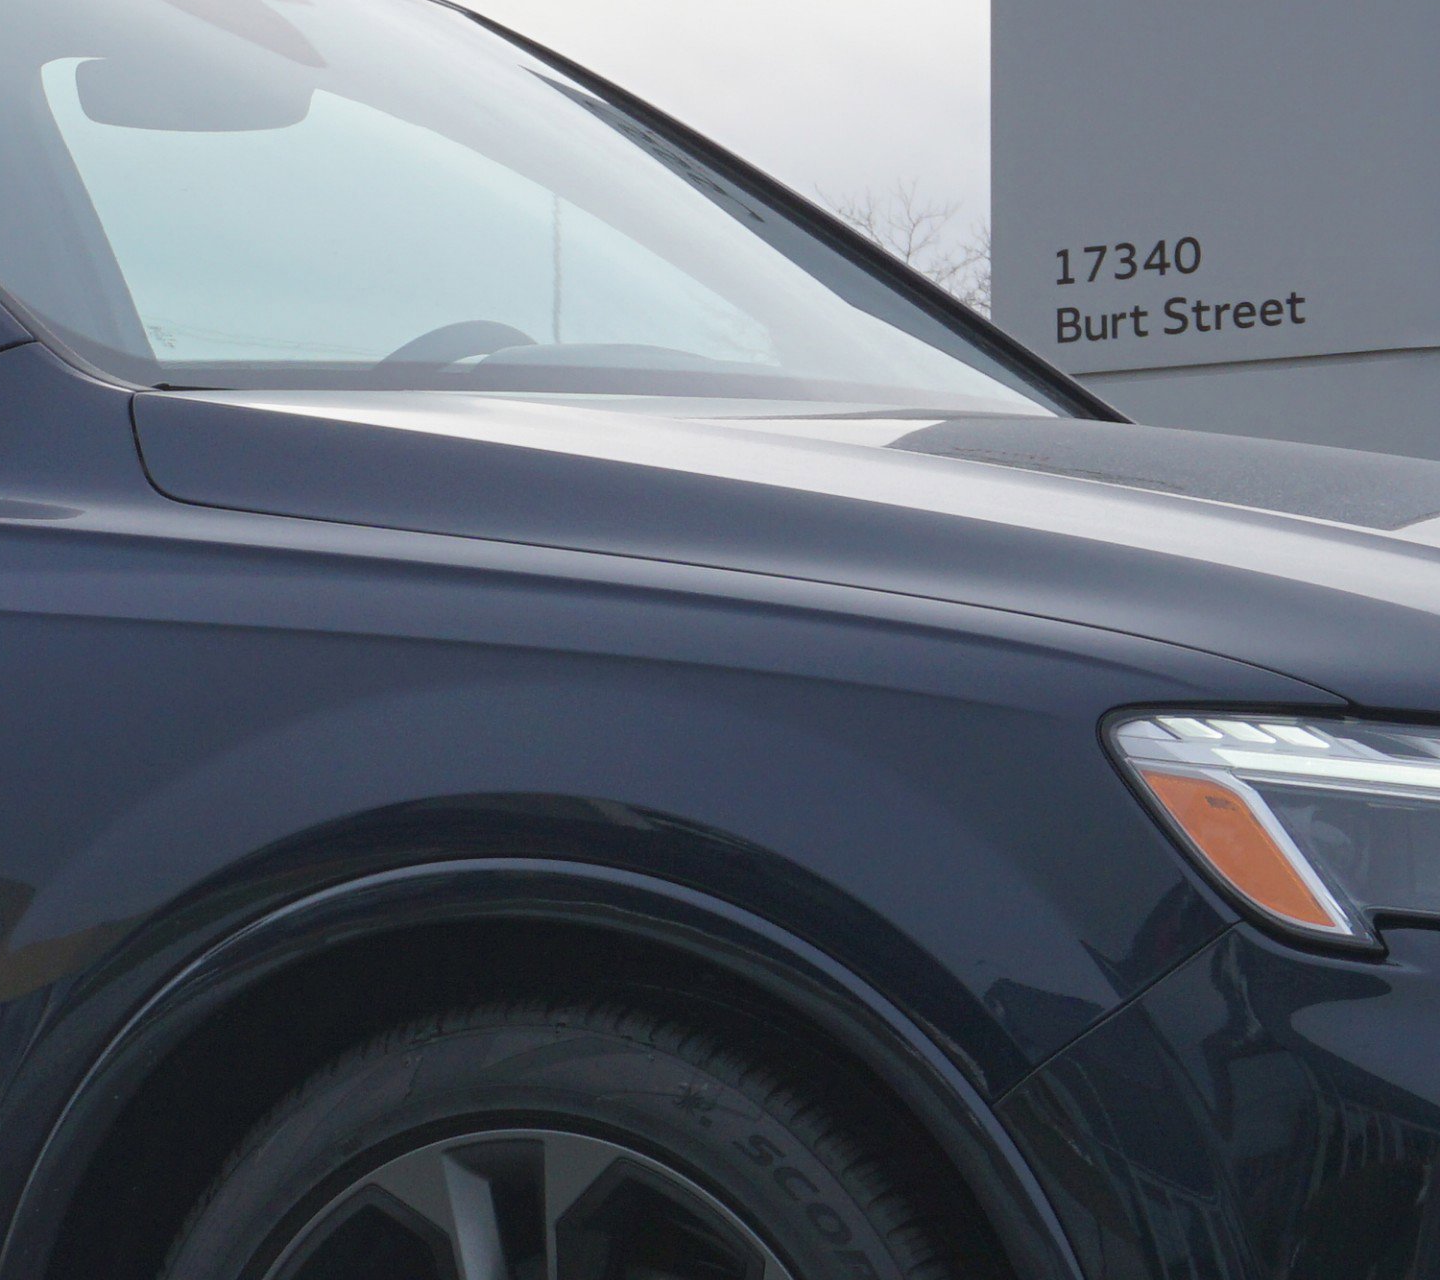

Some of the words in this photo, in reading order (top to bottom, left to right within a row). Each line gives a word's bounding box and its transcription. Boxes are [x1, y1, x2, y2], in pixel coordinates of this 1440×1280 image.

[1055, 236, 1202, 285] 17340
[1056, 304, 1149, 343] Burt
[1163, 291, 1306, 335] Street
